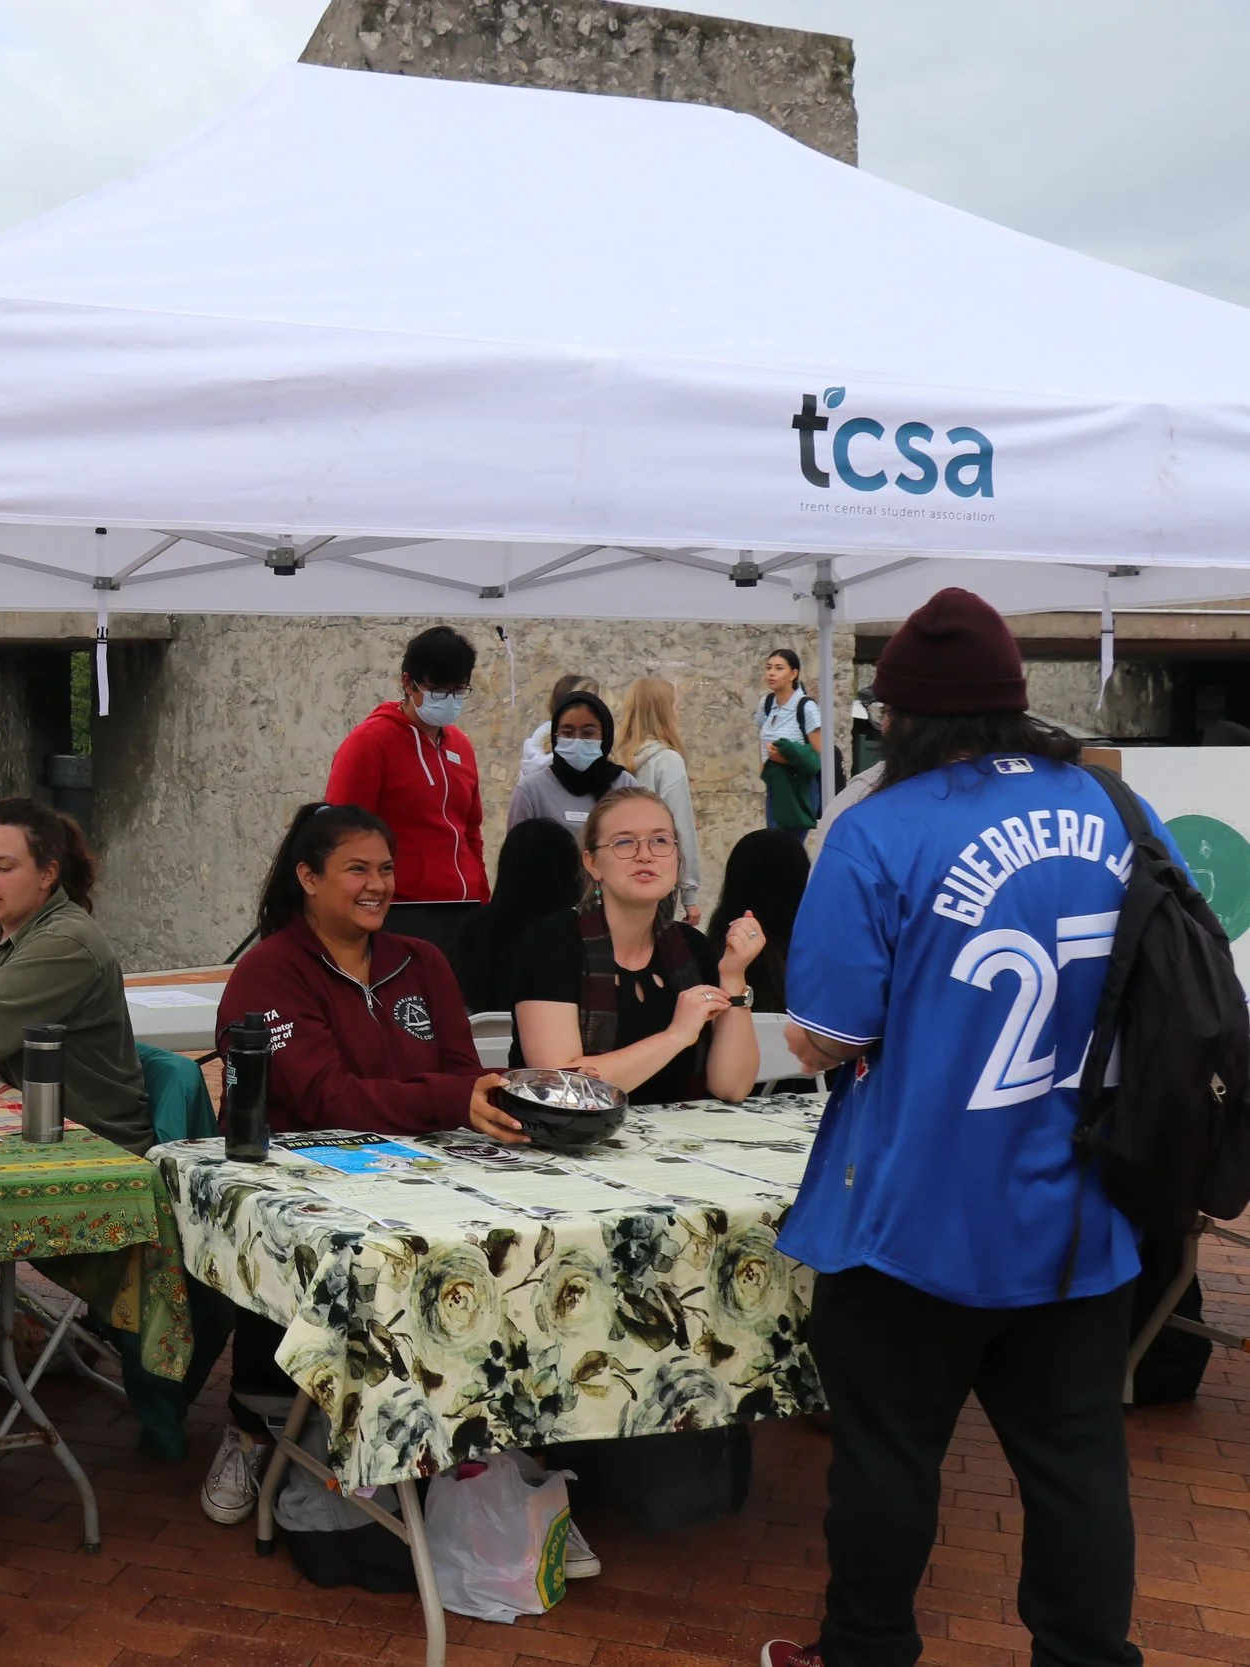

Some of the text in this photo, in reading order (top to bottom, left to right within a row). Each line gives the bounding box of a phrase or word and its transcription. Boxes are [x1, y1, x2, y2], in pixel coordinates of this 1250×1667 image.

[791, 393, 995, 498] tcsa
[800, 502, 996, 523] trent central student association
[933, 808, 1105, 927] GUERRERO
[282, 1029, 293, 1039] of
[950, 910, 1121, 1111] 27
